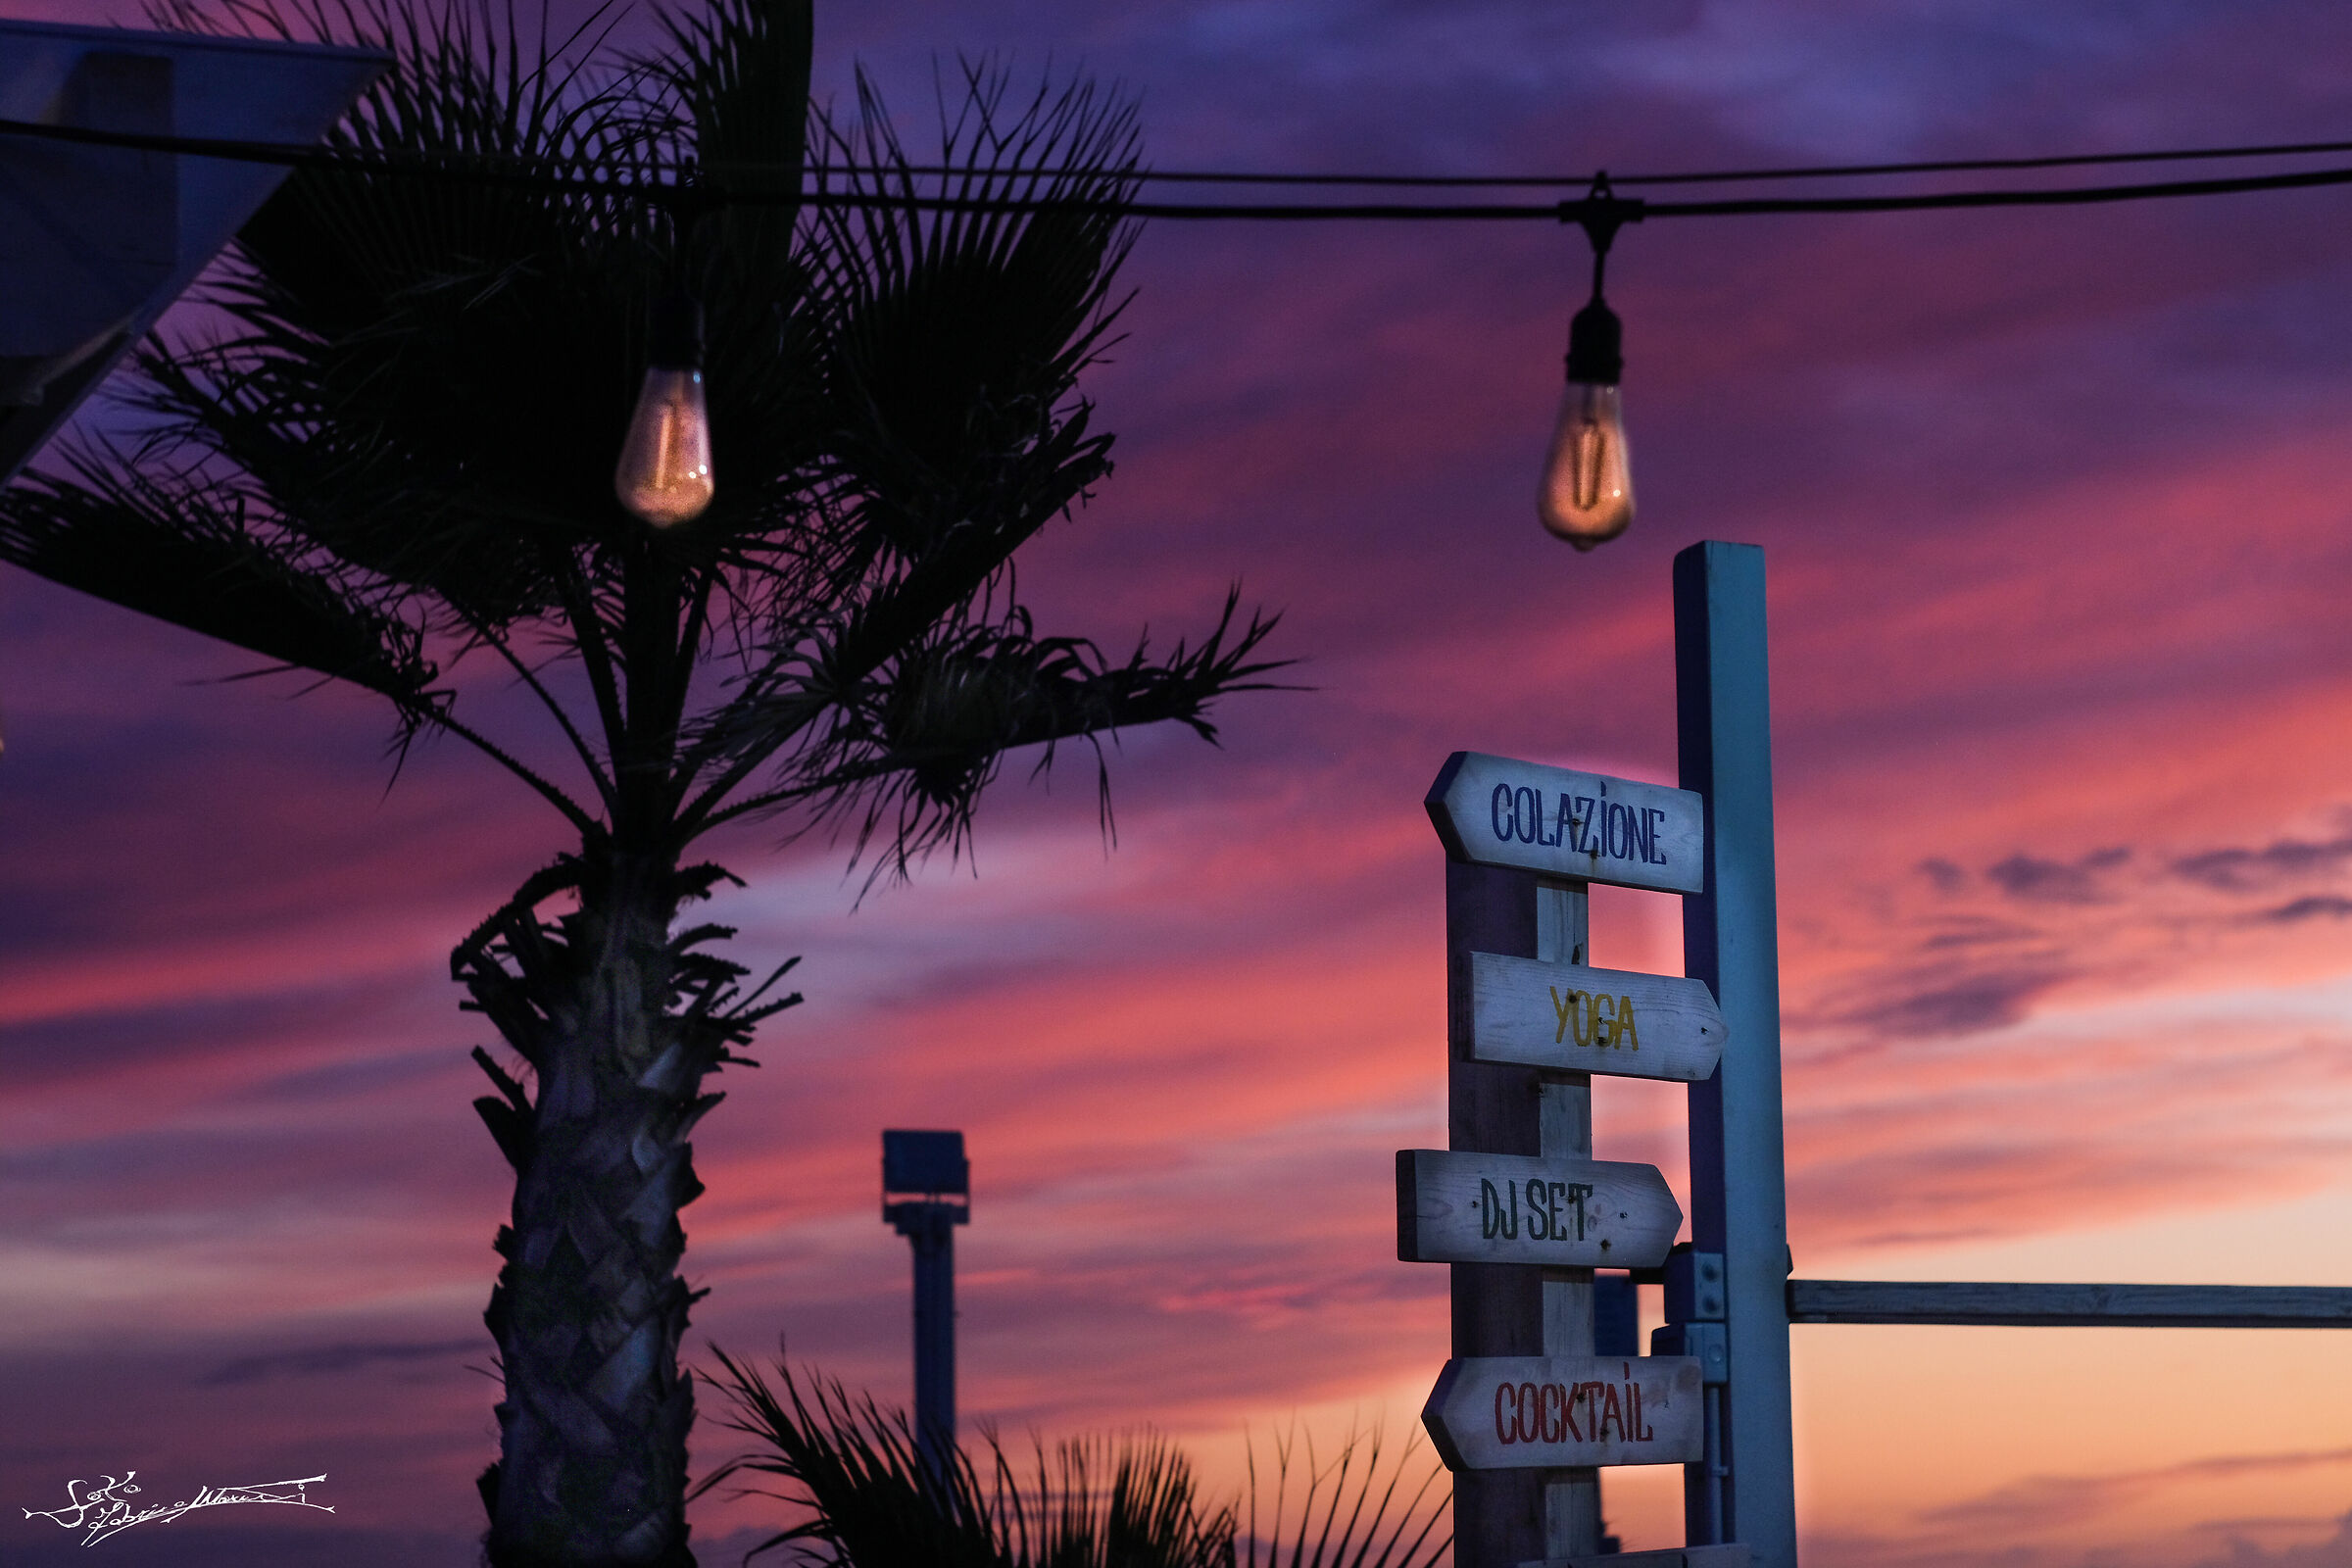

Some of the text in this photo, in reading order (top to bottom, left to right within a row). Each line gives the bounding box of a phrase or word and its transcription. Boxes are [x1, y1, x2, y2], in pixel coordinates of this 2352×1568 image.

[1491, 780, 1667, 865] COLAZIONE
[1549, 985, 1640, 1052] YOGA
[1480, 1177, 1593, 1242] DJ SET
[1494, 1361, 1654, 1446] COCKTAIL
